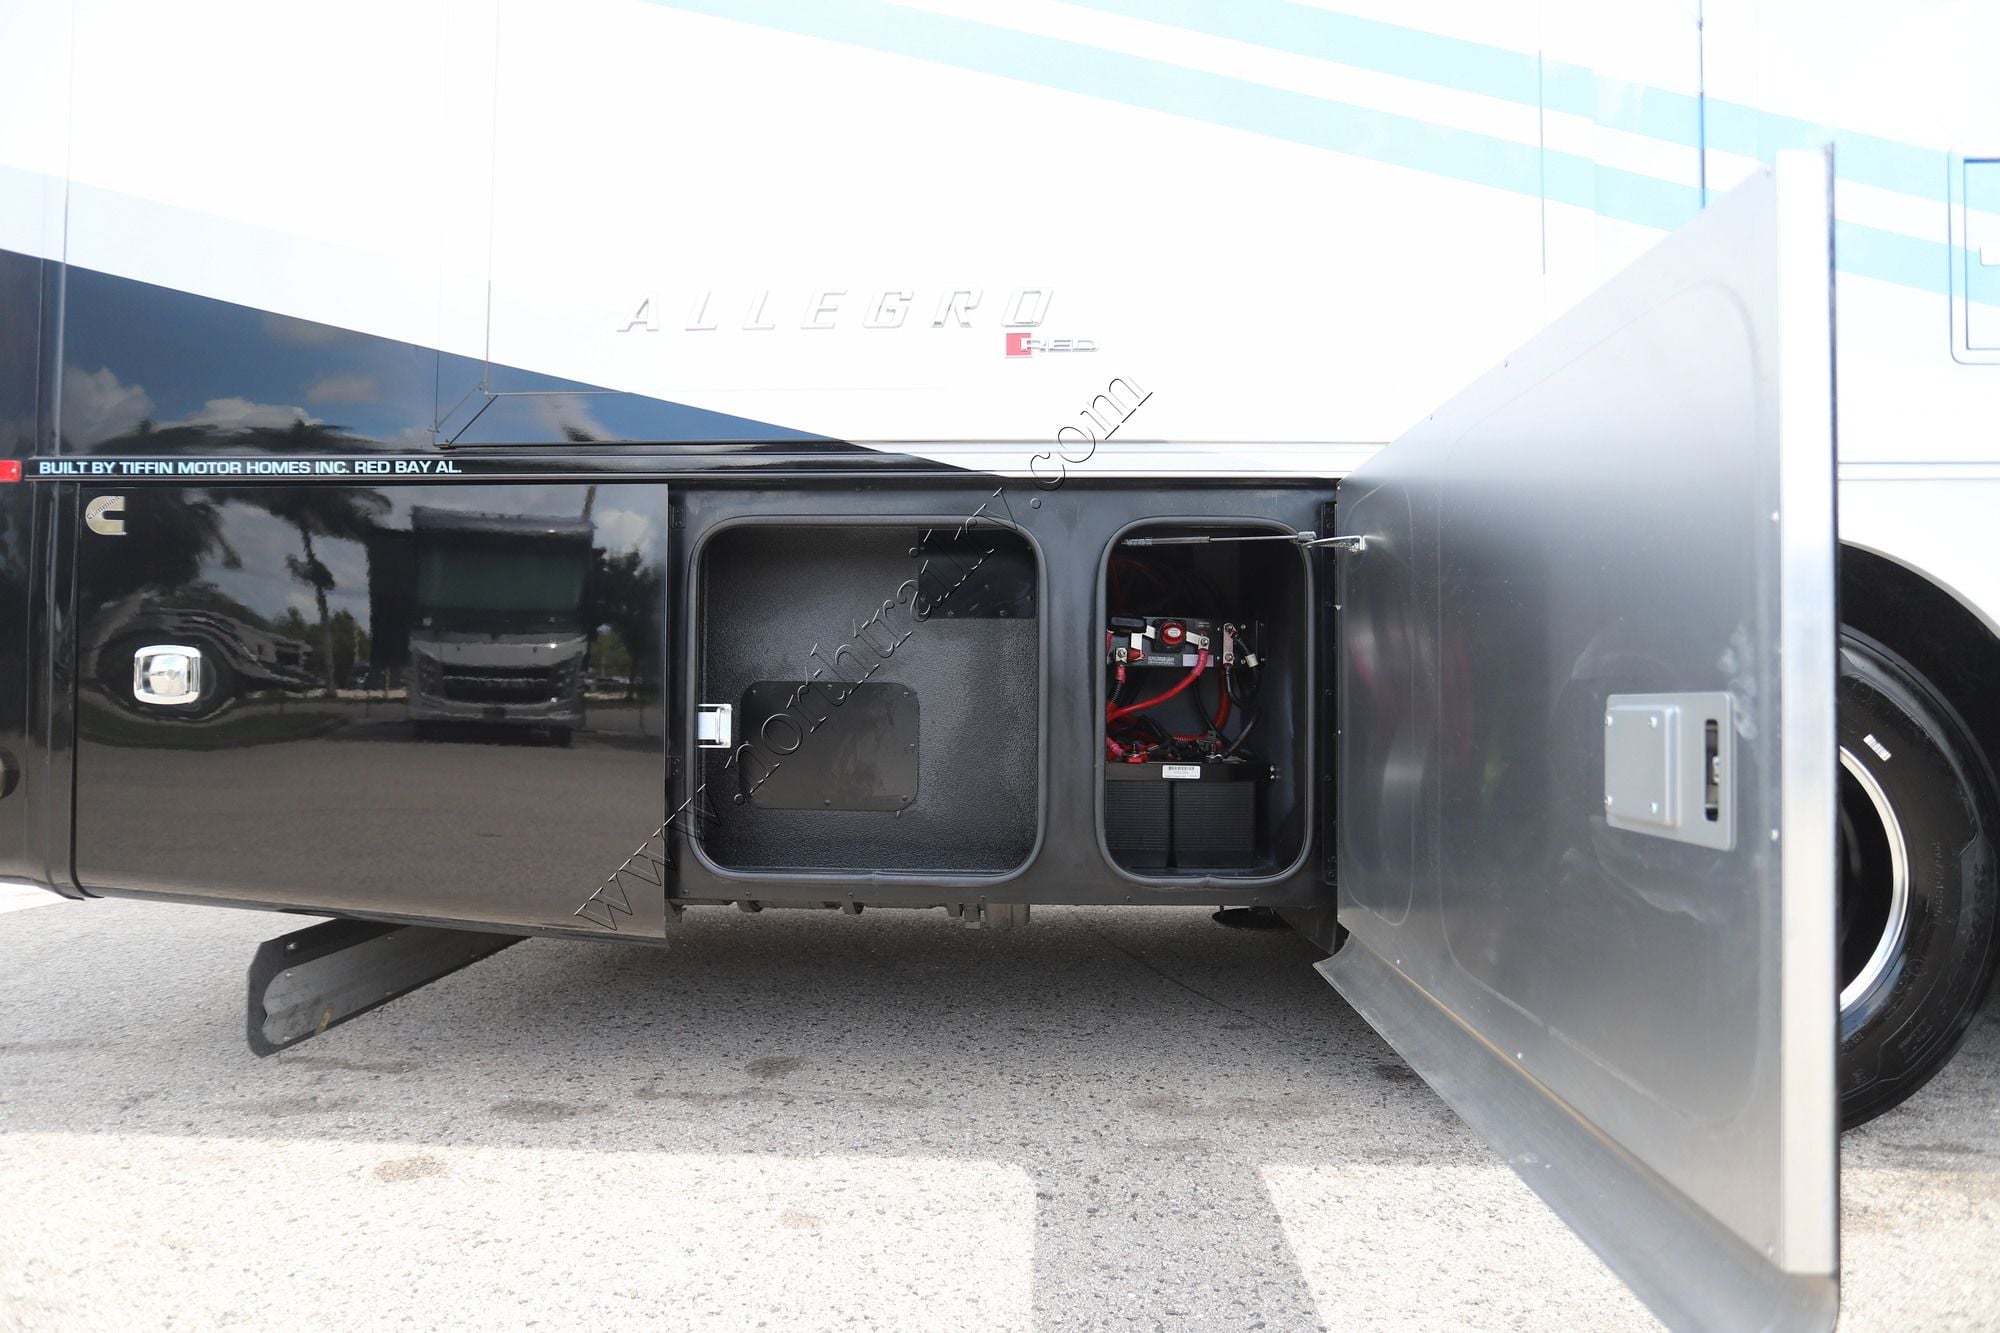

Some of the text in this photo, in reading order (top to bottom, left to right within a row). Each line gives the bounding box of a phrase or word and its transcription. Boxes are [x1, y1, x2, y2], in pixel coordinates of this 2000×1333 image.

[616, 287, 1054, 333] ALLEGRO
[1020, 337, 1099, 352] RED
[39, 461, 462, 475] BUILT BY TIFFIN MOTOR HOMES INC. RED BAY AL.
